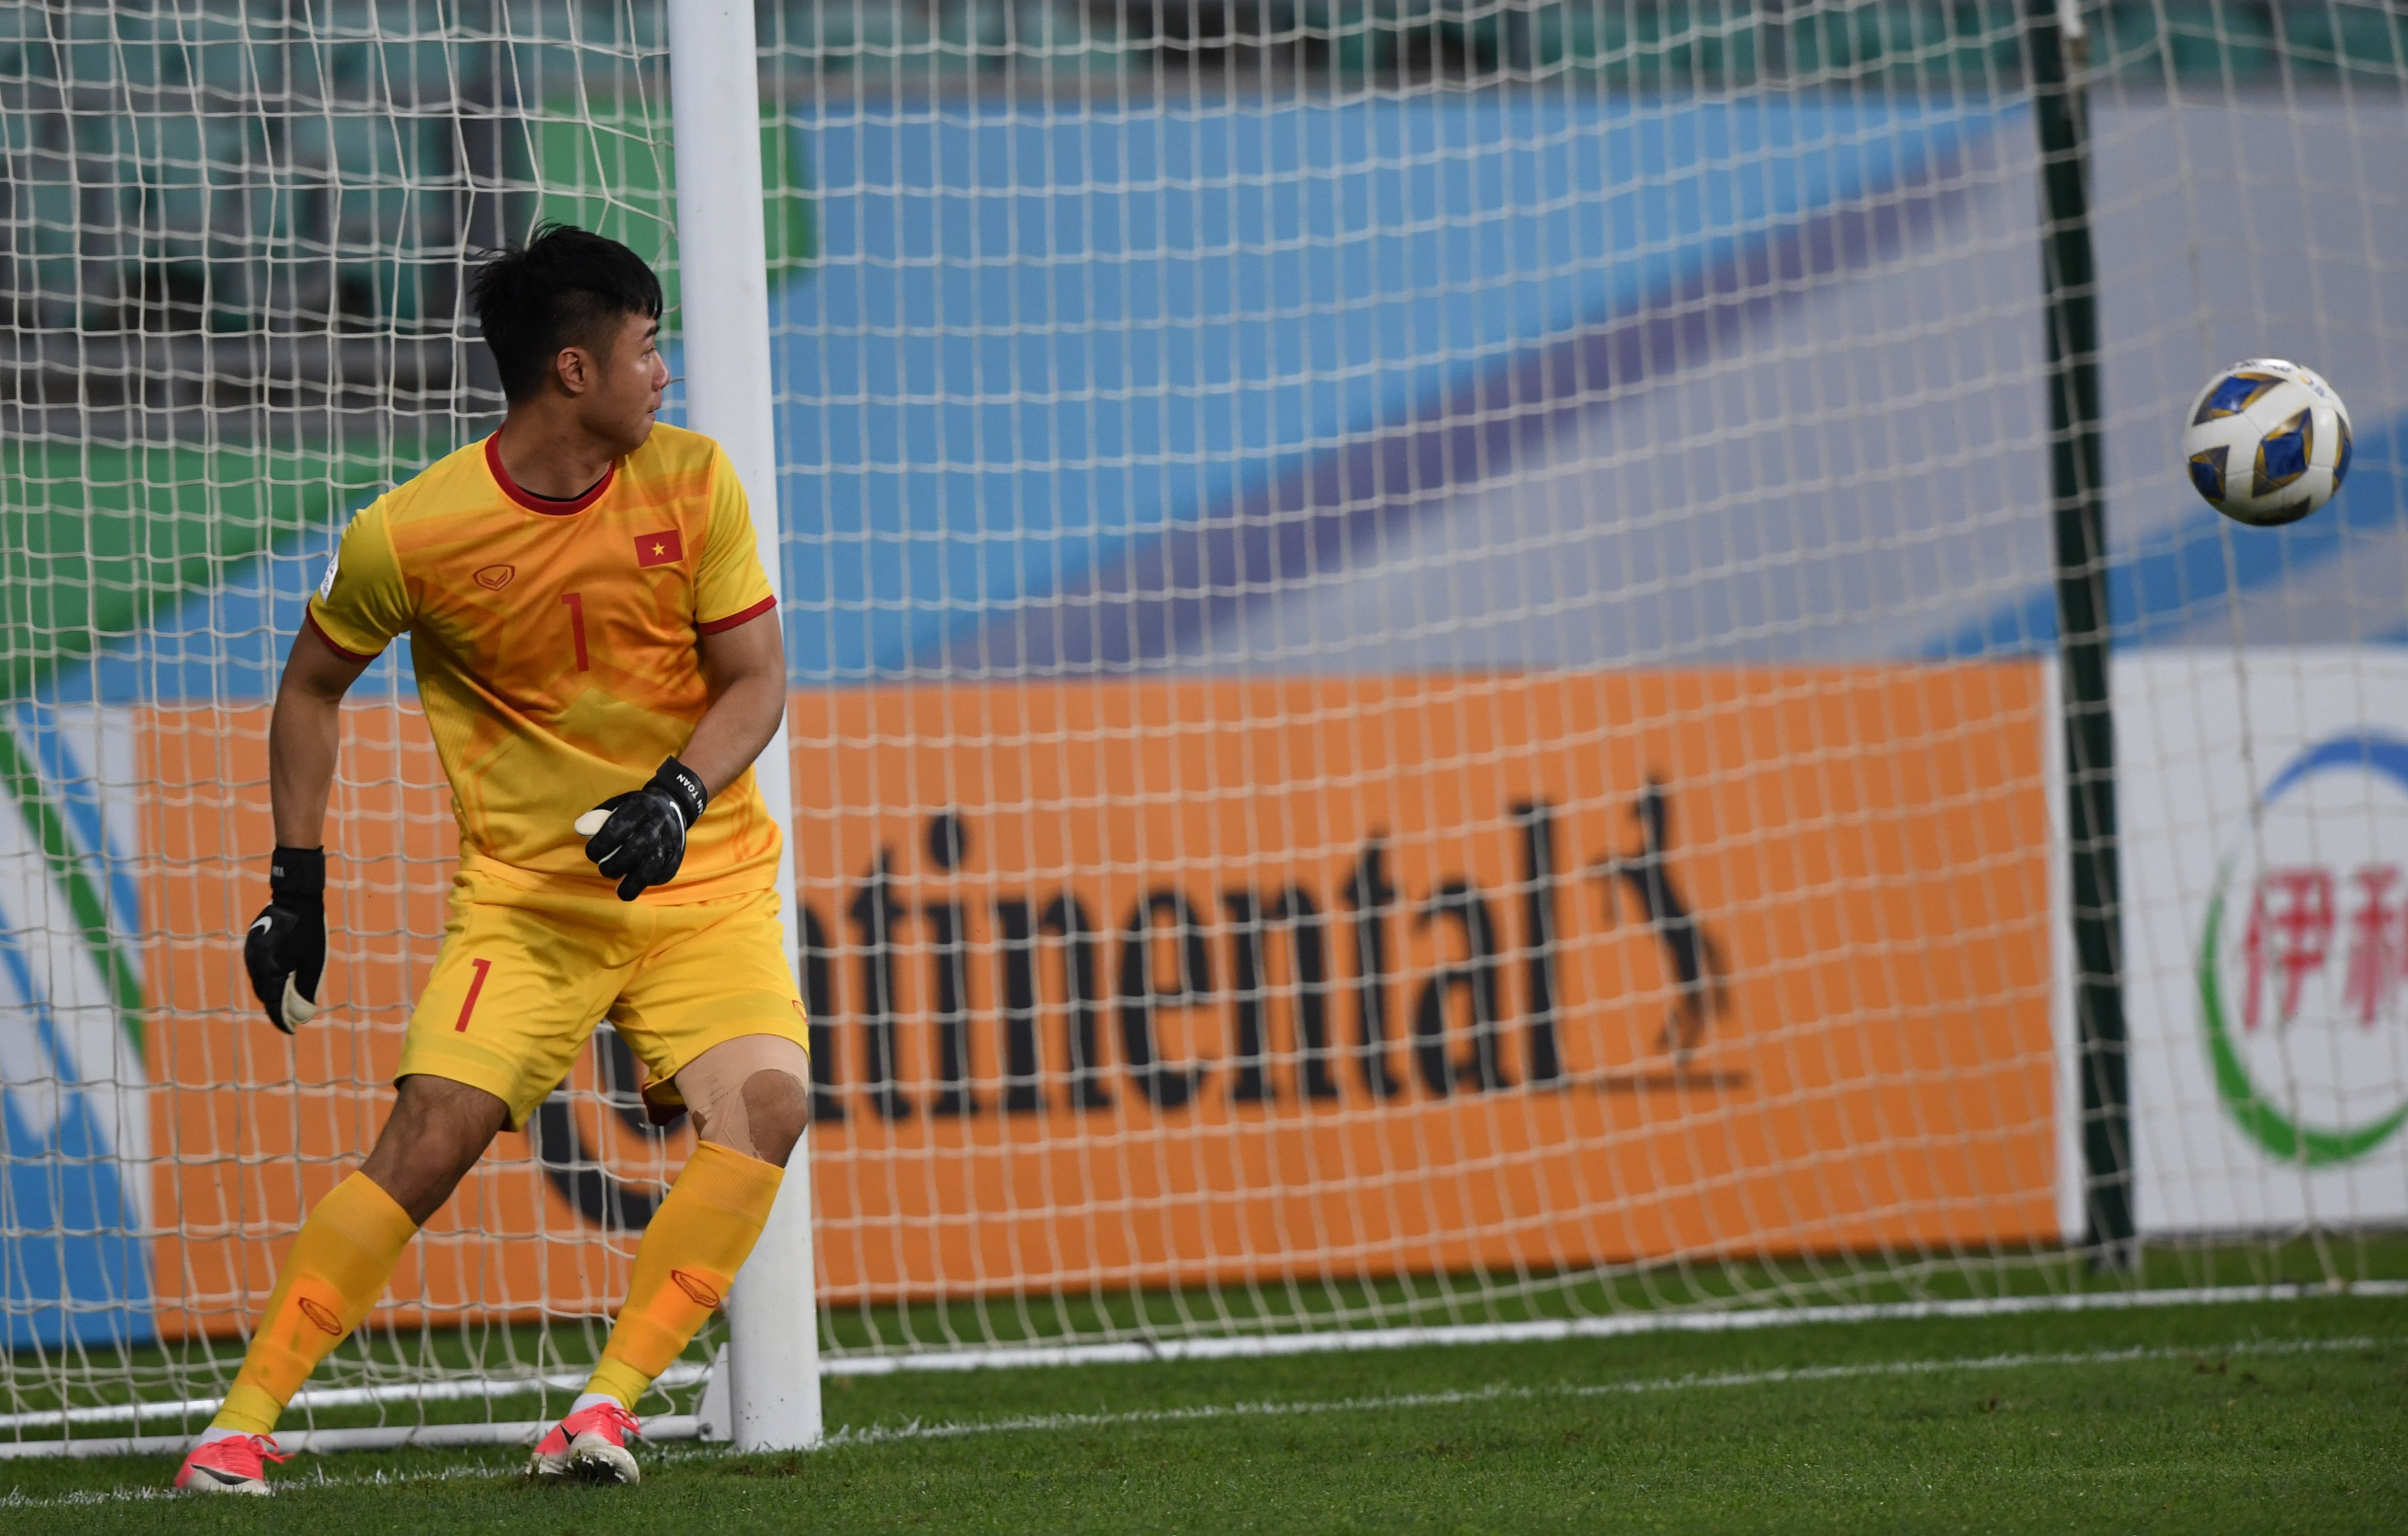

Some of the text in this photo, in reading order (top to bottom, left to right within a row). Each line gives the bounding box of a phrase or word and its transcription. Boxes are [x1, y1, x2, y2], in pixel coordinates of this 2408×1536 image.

[561, 593, 588, 672] 1
[676, 773, 698, 799] TOAN
[455, 958, 491, 1033] 1
[536, 799, 1571, 1234] tinental
